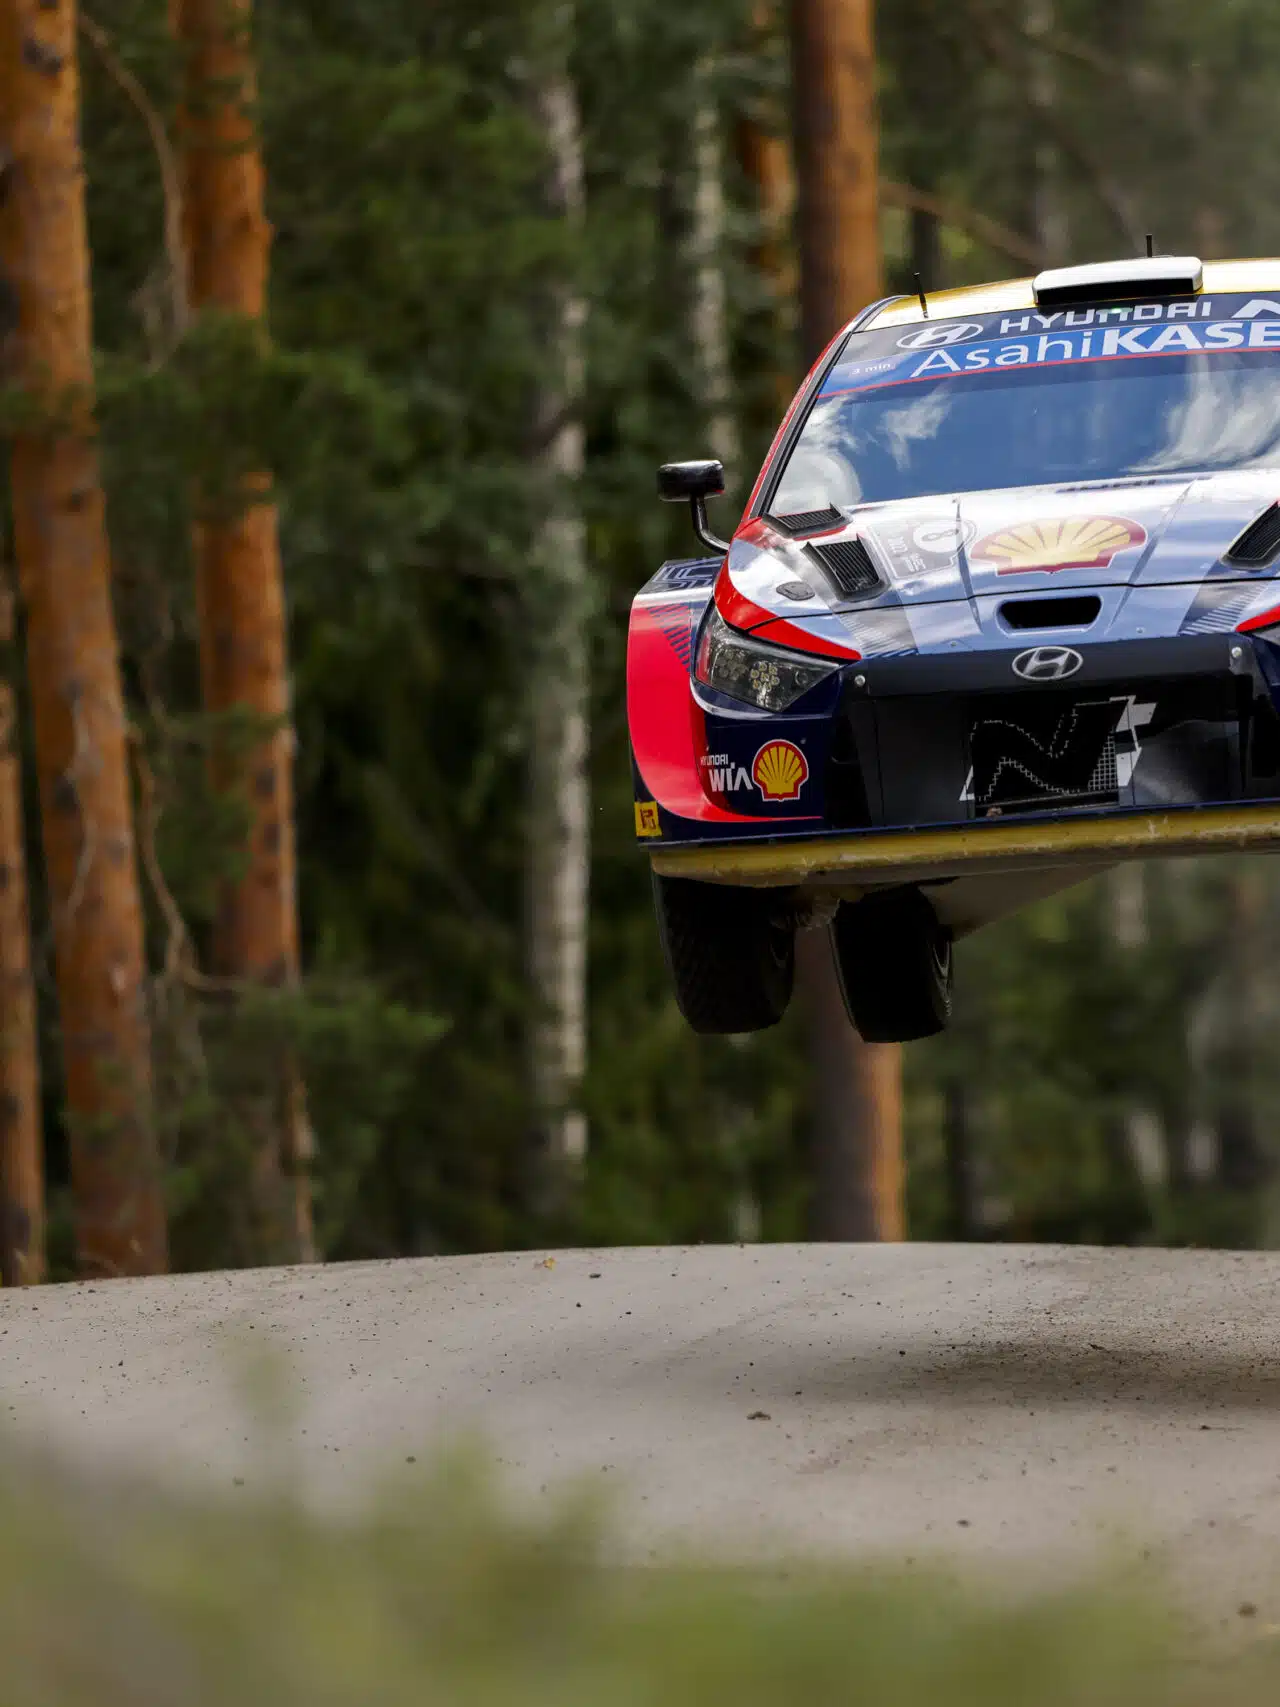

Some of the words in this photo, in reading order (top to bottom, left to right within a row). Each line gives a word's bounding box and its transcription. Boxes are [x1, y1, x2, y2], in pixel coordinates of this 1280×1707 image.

[999, 301, 1212, 334] HYUNDAI
[700, 754, 729, 766] HYUNDAI
[708, 762, 754, 792] WIA
